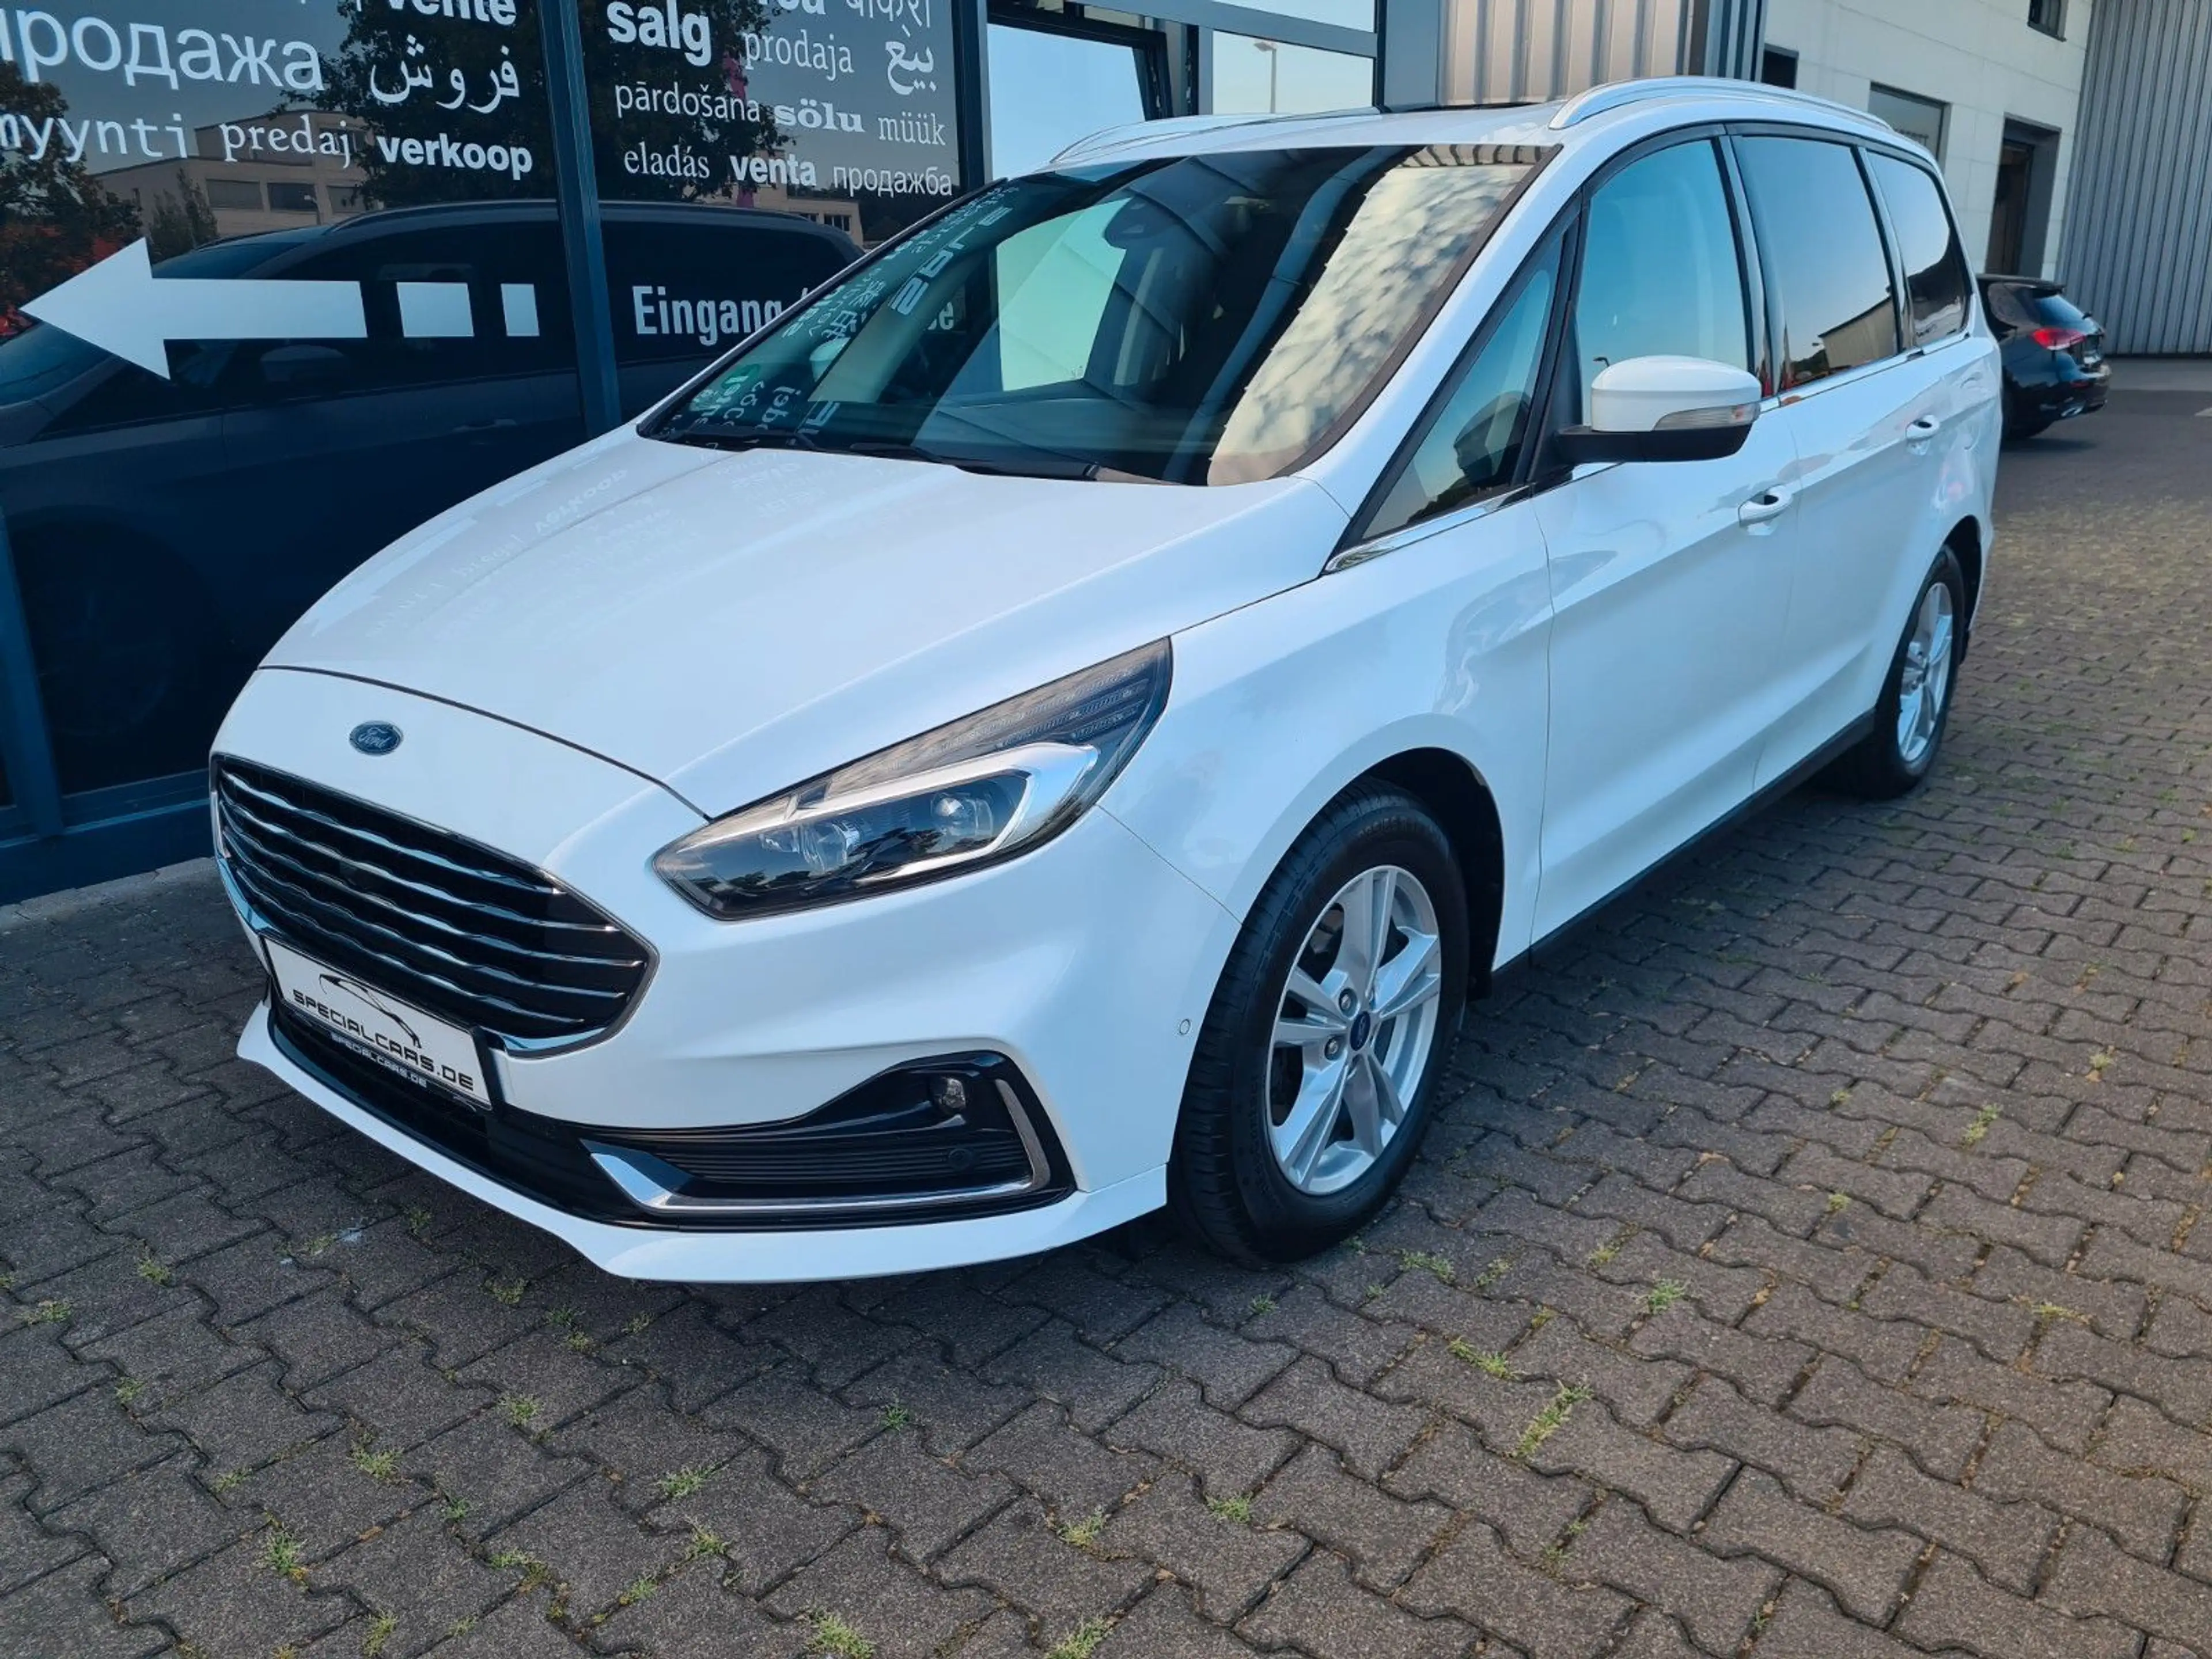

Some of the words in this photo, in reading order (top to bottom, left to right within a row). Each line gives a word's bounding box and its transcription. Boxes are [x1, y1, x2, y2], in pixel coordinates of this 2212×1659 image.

[607, 0, 711, 66] salg
[741, 29, 854, 81] prodaja
[370, 34, 520, 113] فروش
[615, 81, 760, 122] pārdošana
[774, 98, 865, 132] sölu
[877, 111, 945, 145] müük
[219, 115, 350, 168] predaj
[377, 133, 533, 180] verkoop
[624, 141, 710, 179] eladás
[729, 153, 816, 186] venta
[833, 165, 952, 198] продажба
[293, 988, 474, 1091] SPECIALCARS.DE
